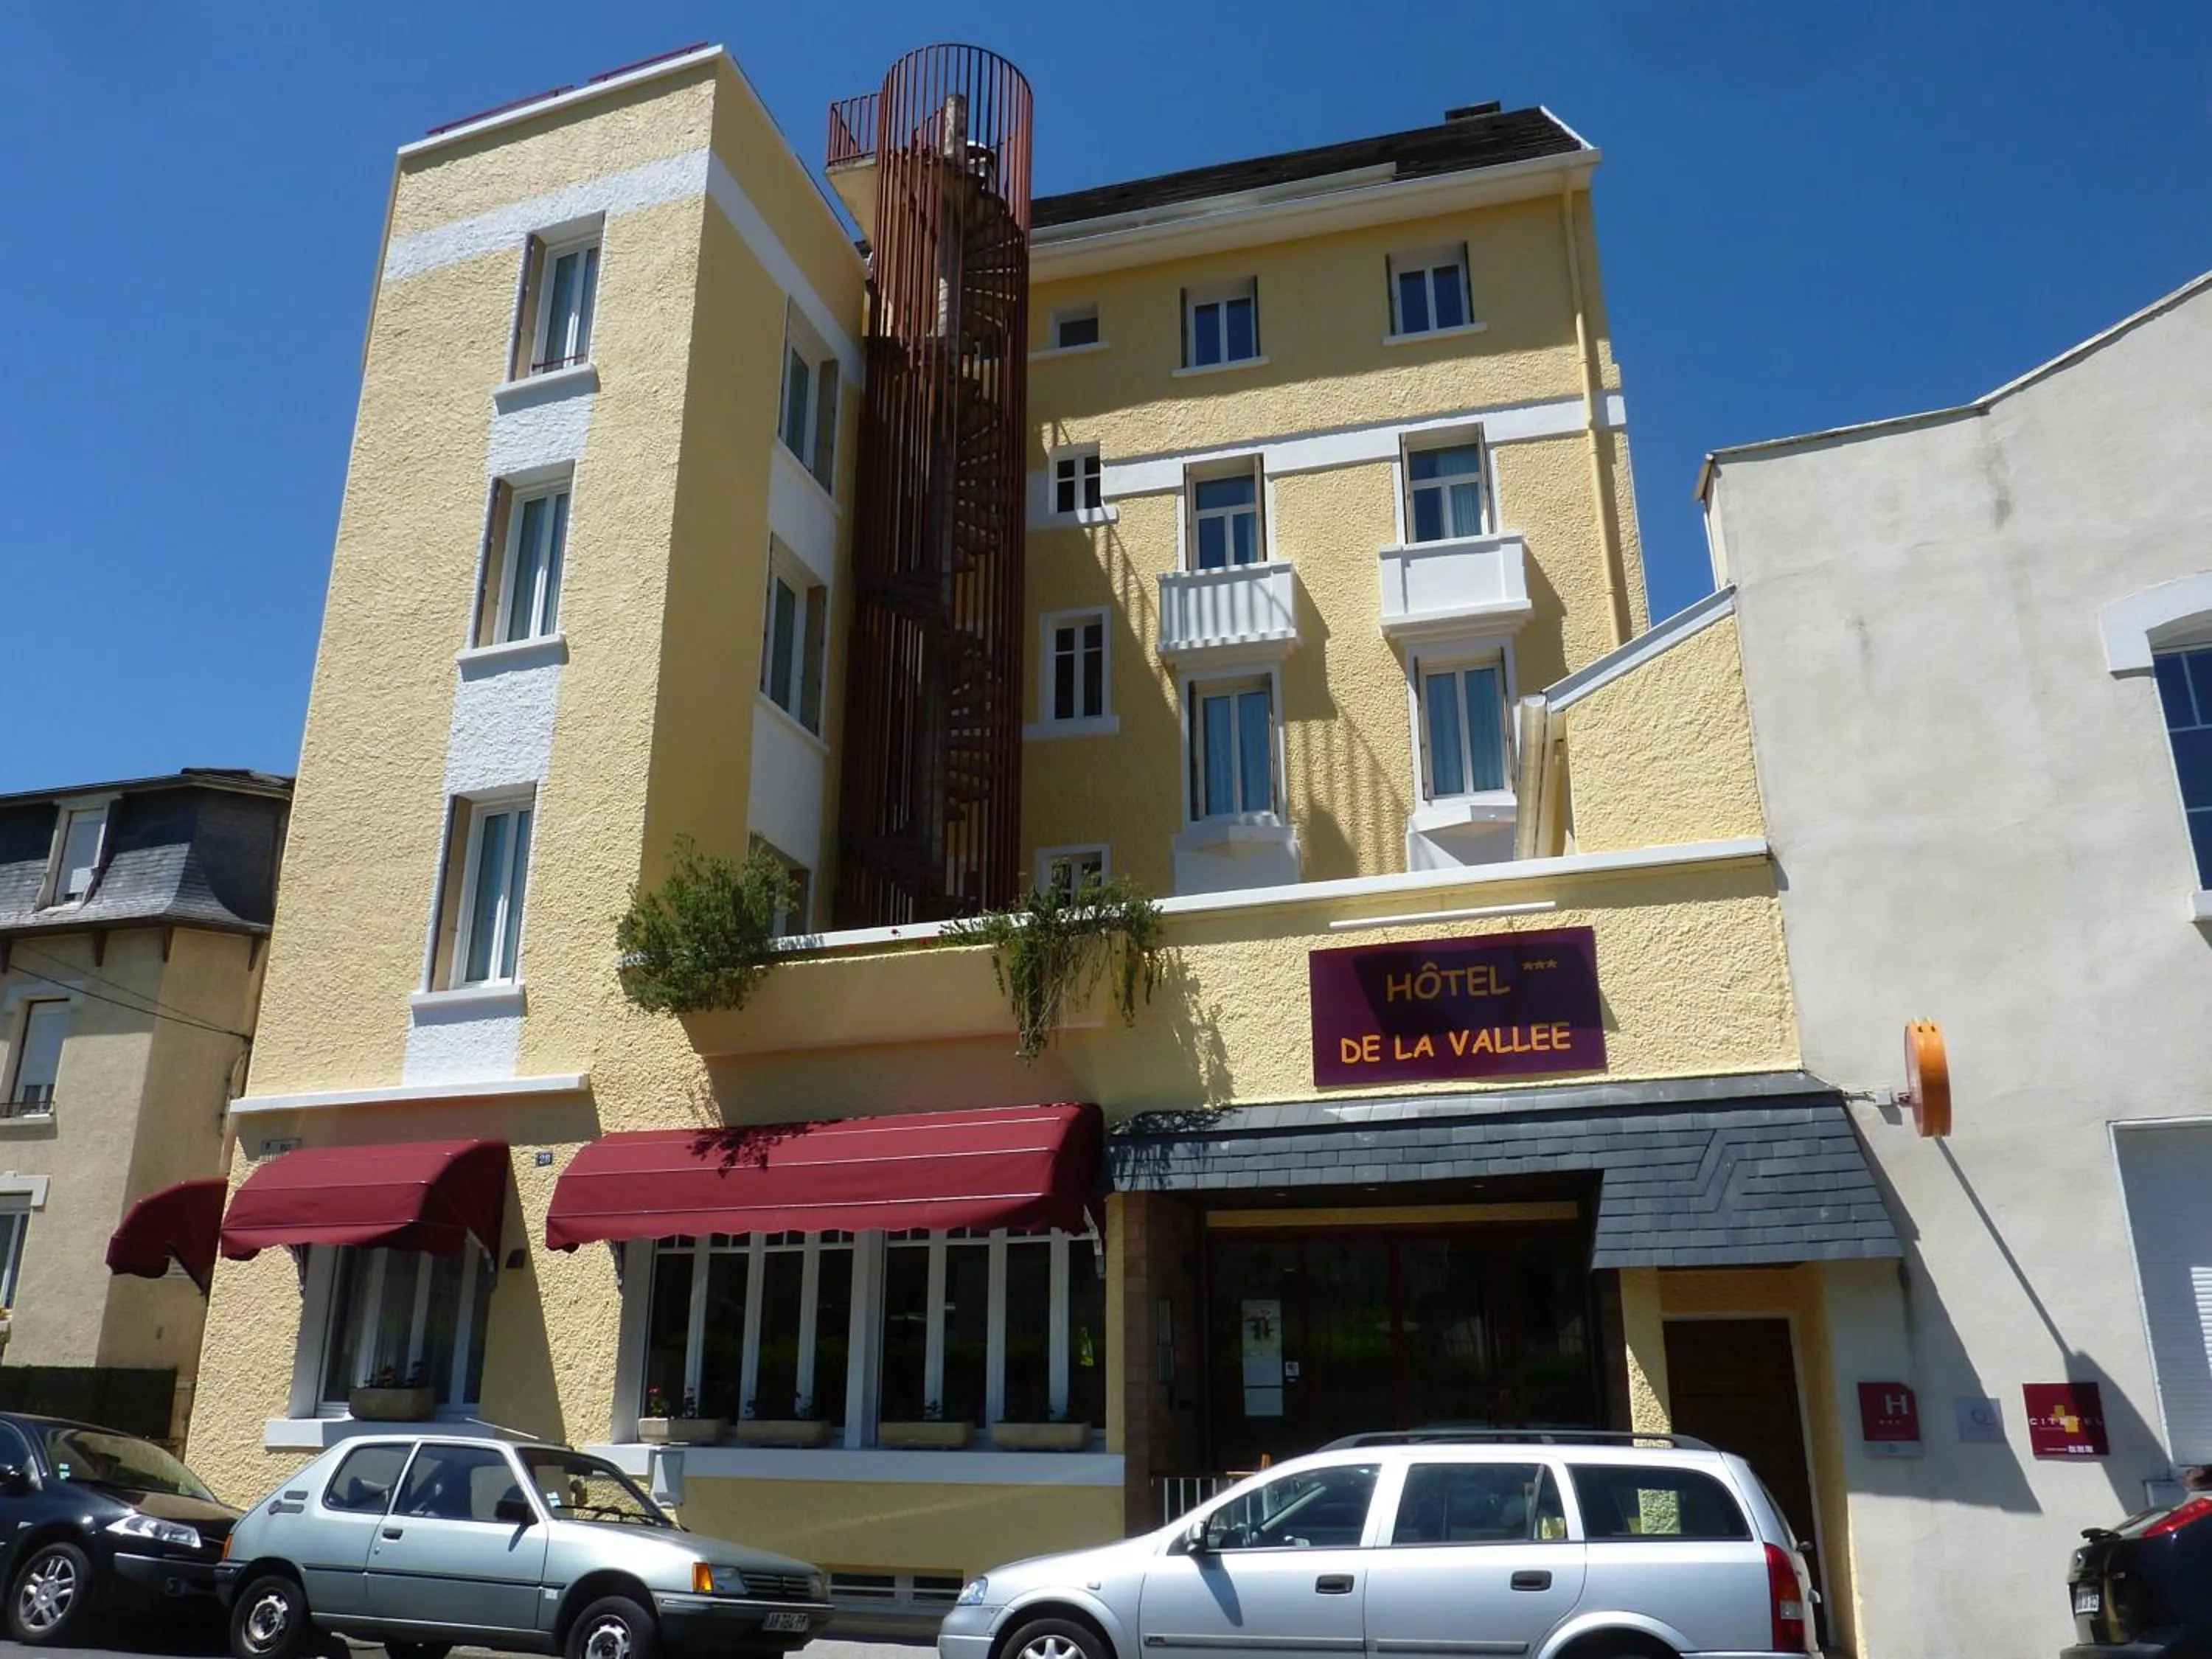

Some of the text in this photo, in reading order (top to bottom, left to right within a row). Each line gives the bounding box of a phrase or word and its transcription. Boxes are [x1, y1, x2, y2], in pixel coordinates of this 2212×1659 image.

[1386, 961, 1511, 1002] HÔTEL
[1340, 1022, 1572, 1063] DE LA VALLEE
[1885, 1394, 1908, 1415] H
